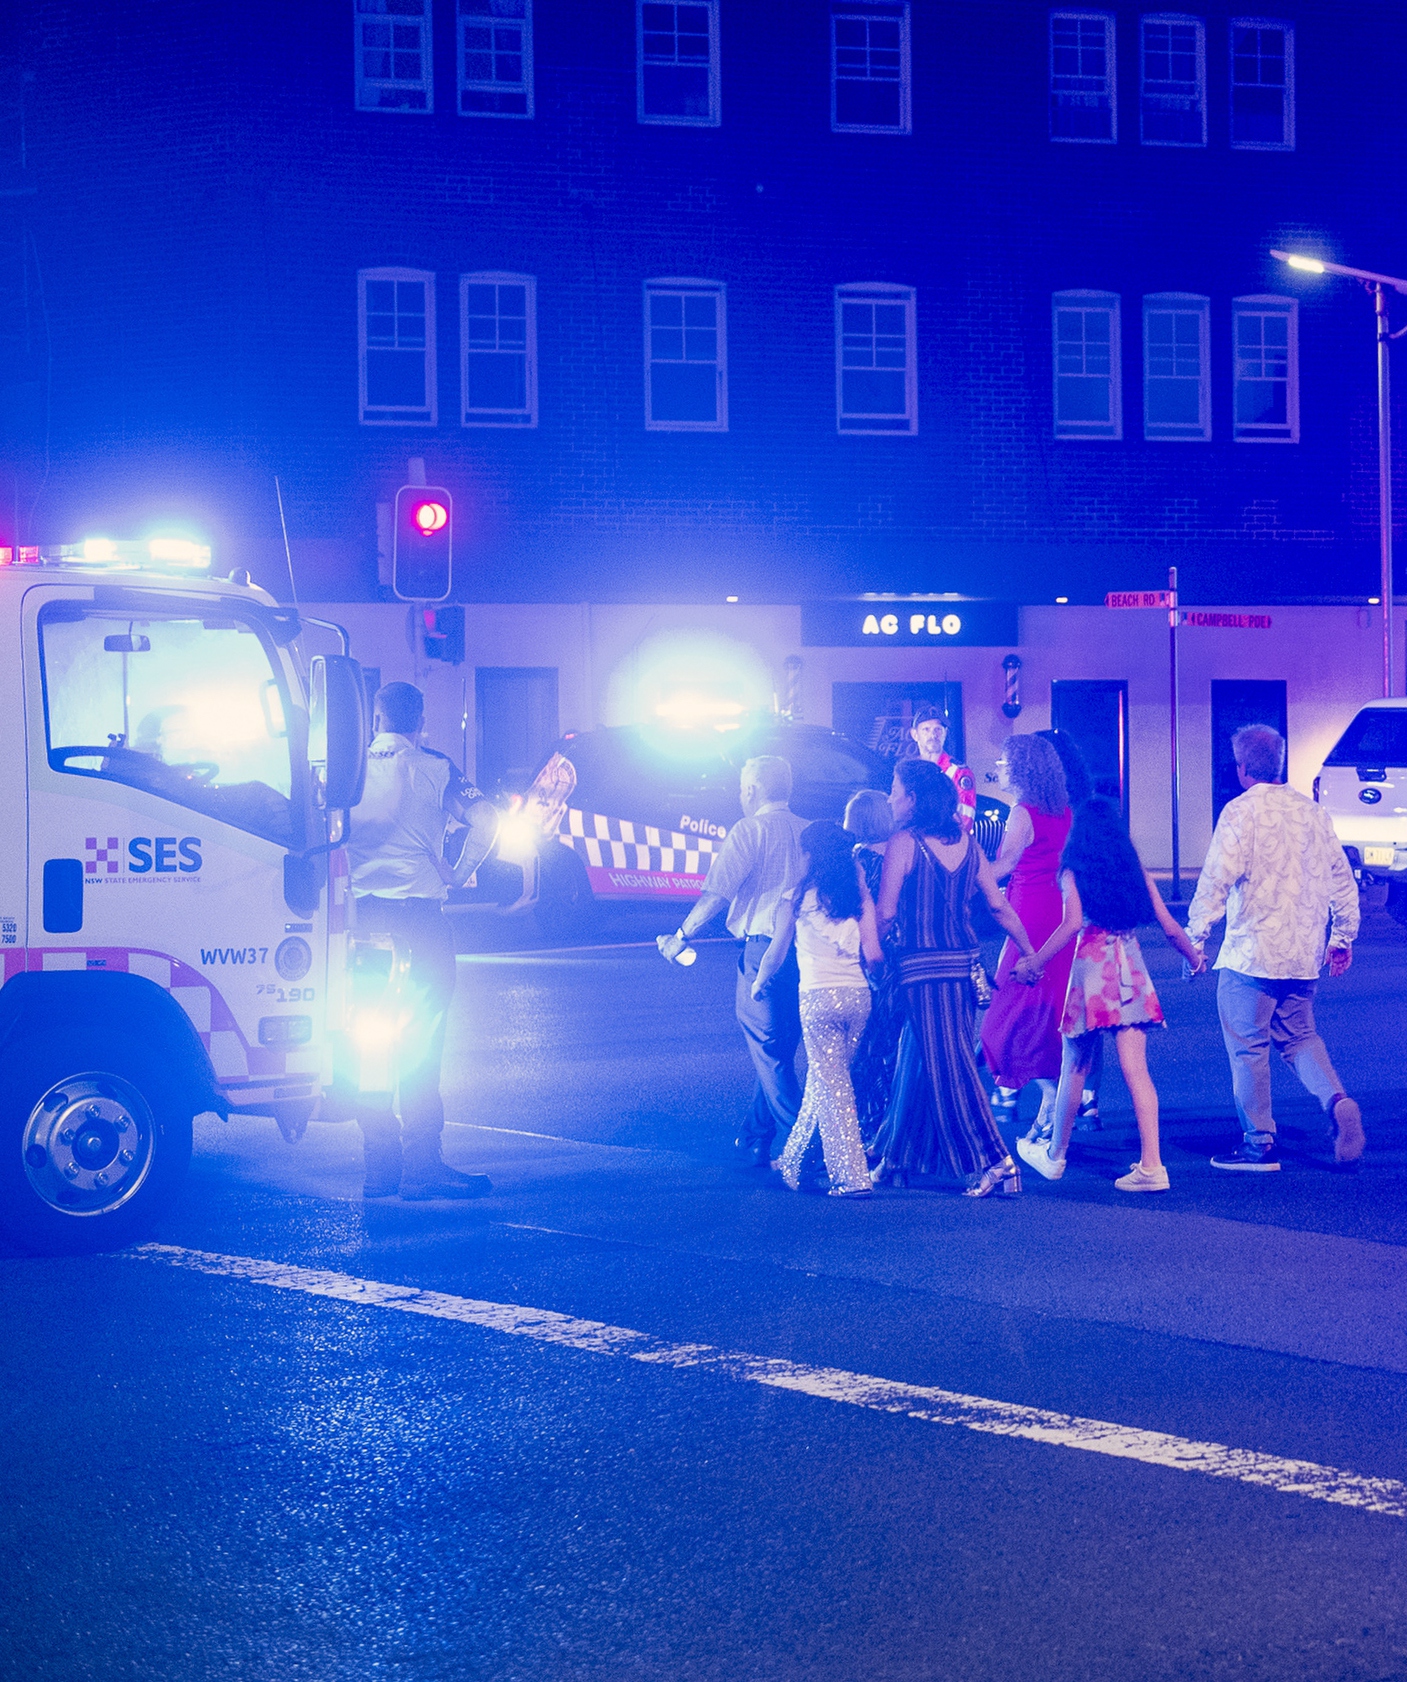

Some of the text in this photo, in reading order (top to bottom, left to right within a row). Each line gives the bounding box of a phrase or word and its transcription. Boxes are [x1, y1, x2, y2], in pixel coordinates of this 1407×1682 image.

[1111, 593, 1155, 607] BEACH RD
[862, 614, 961, 635] AC FLO
[1197, 613, 1244, 627] CAMPBELL
[680, 814, 727, 839] Police
[128, 836, 203, 873] SES
[608, 873, 672, 889] HIGHWAY
[200, 947, 269, 965] WVW37
[276, 987, 315, 1002] 190
